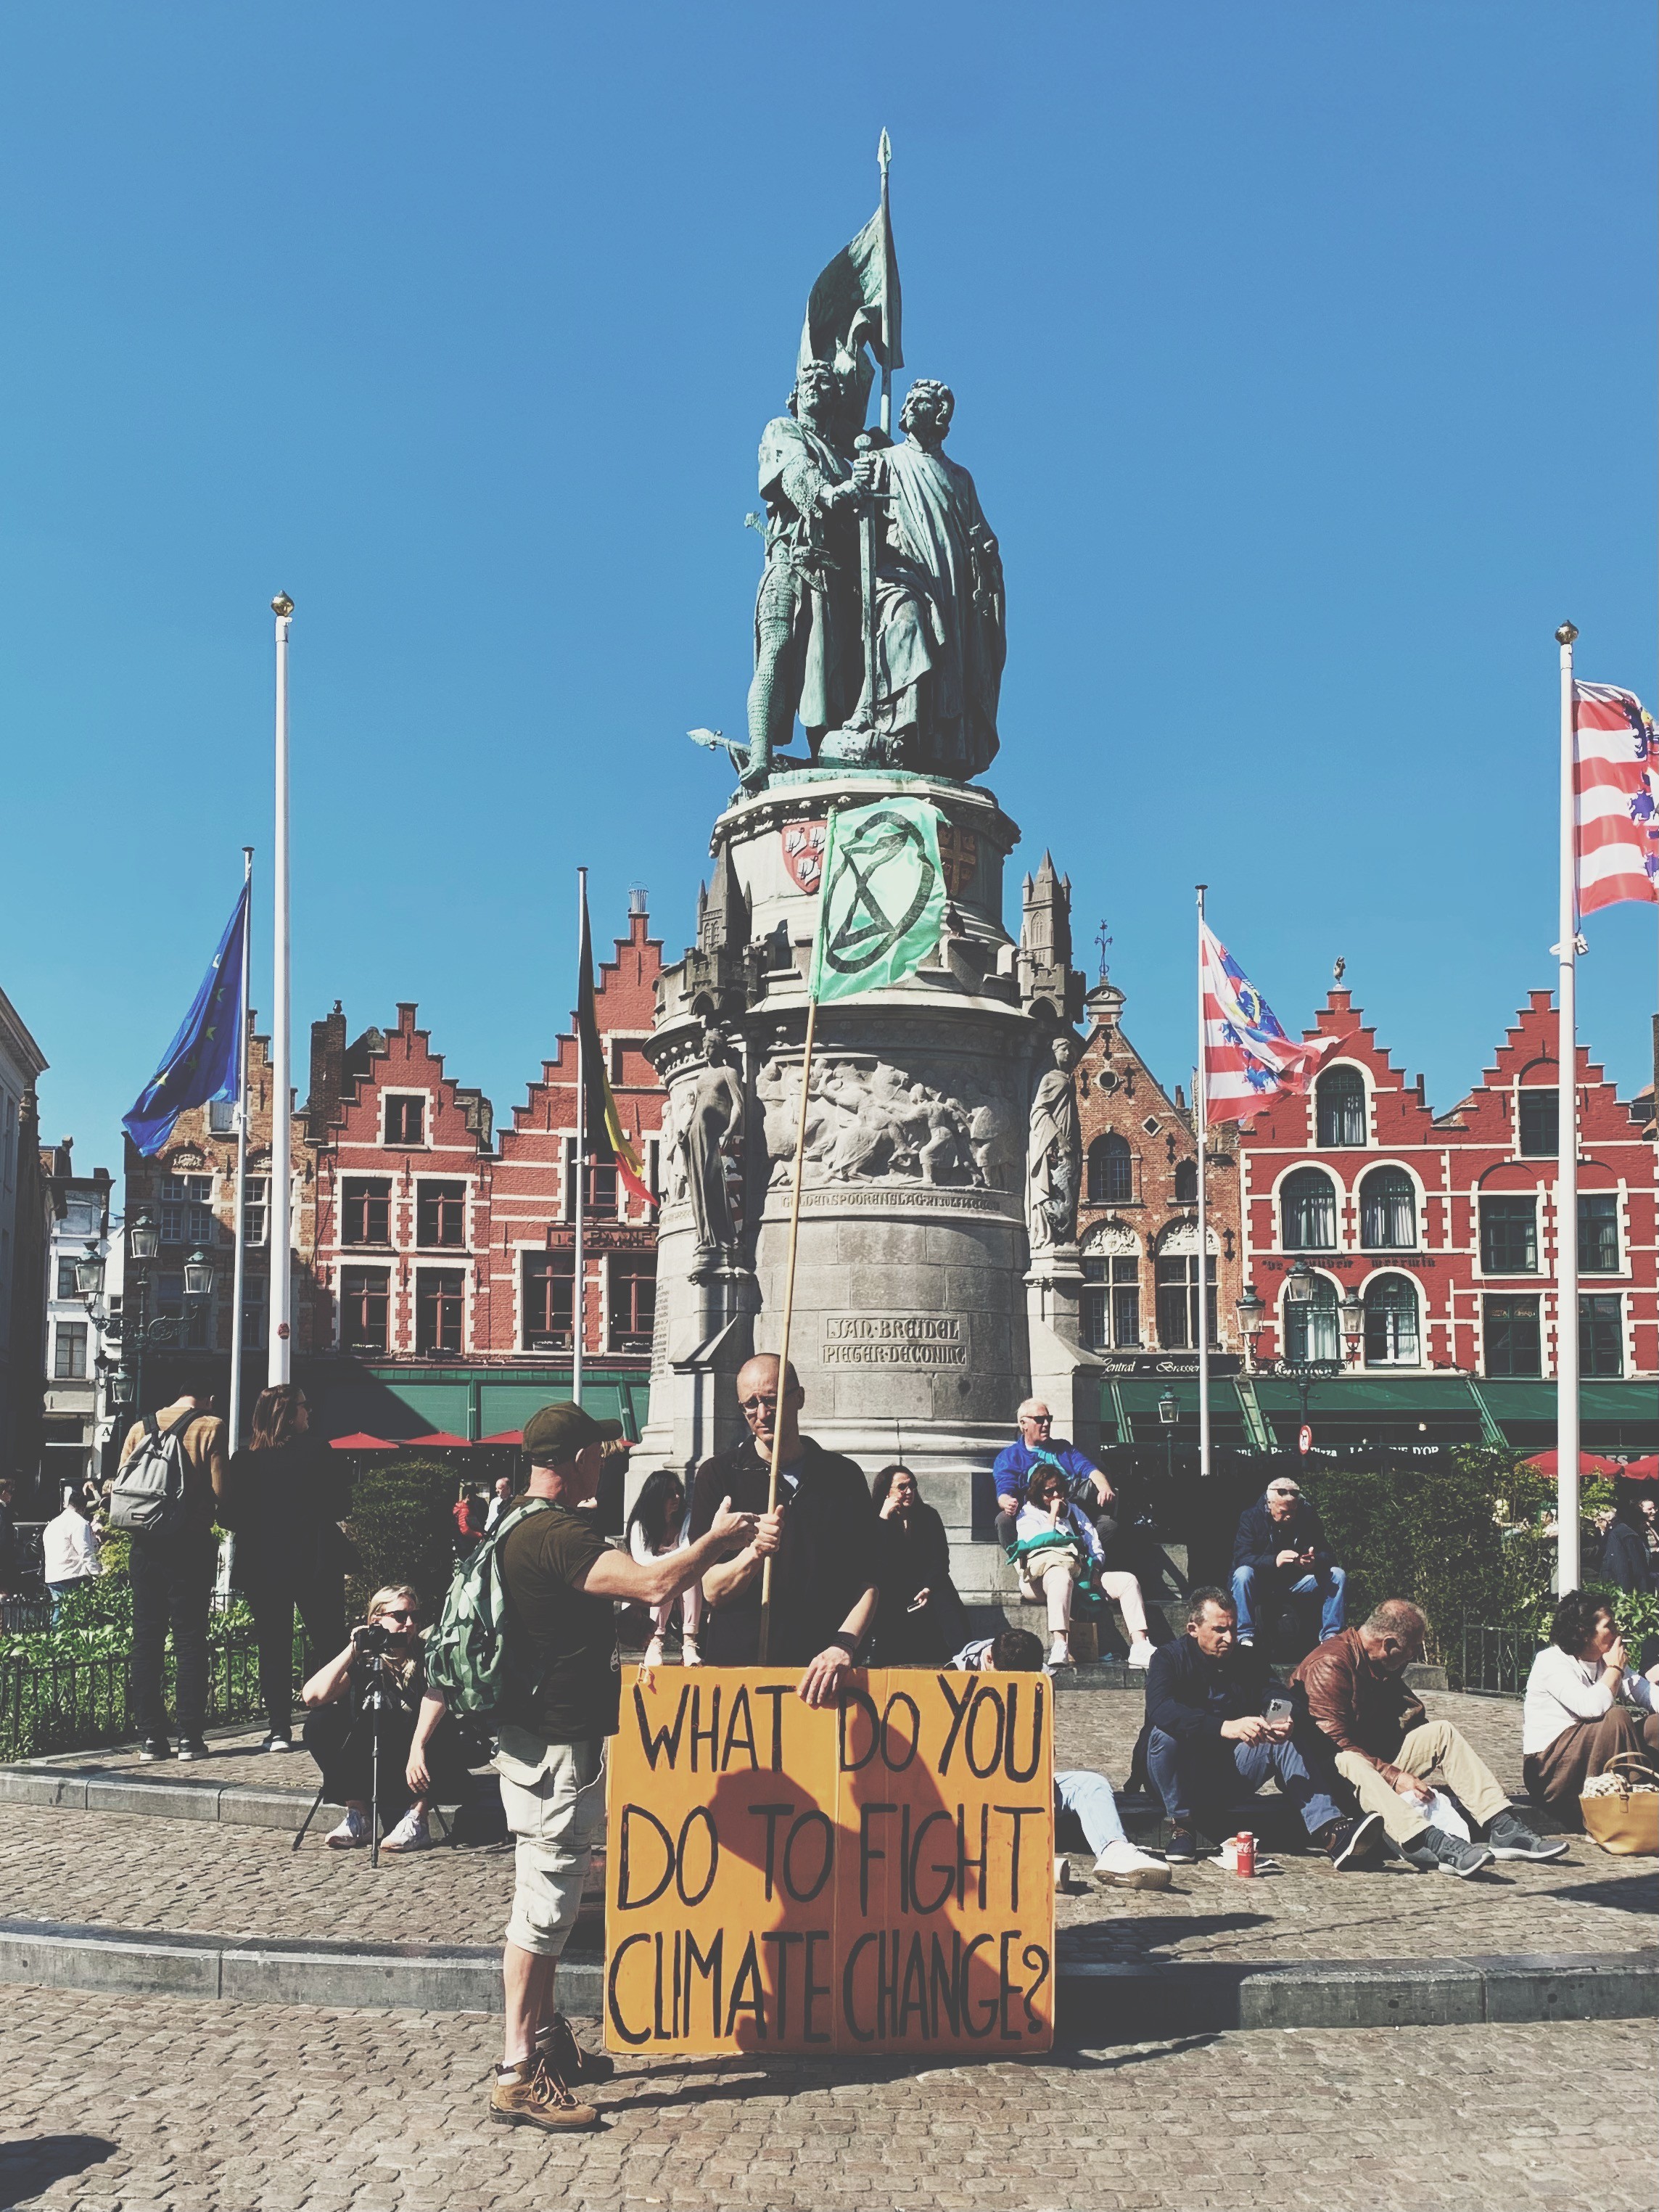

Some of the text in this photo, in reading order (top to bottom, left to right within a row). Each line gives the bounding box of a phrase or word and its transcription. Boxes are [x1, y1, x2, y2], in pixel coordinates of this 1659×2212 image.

[831, 1320, 873, 1339] JAN
[1156, 1361, 1201, 1372] Brasser
[633, 1674, 1045, 1783] WHAT DO YOU
[617, 1803, 1045, 1918] DO TO FIGHT
[608, 1928, 1050, 2045] CLIMATE CHANGE?
